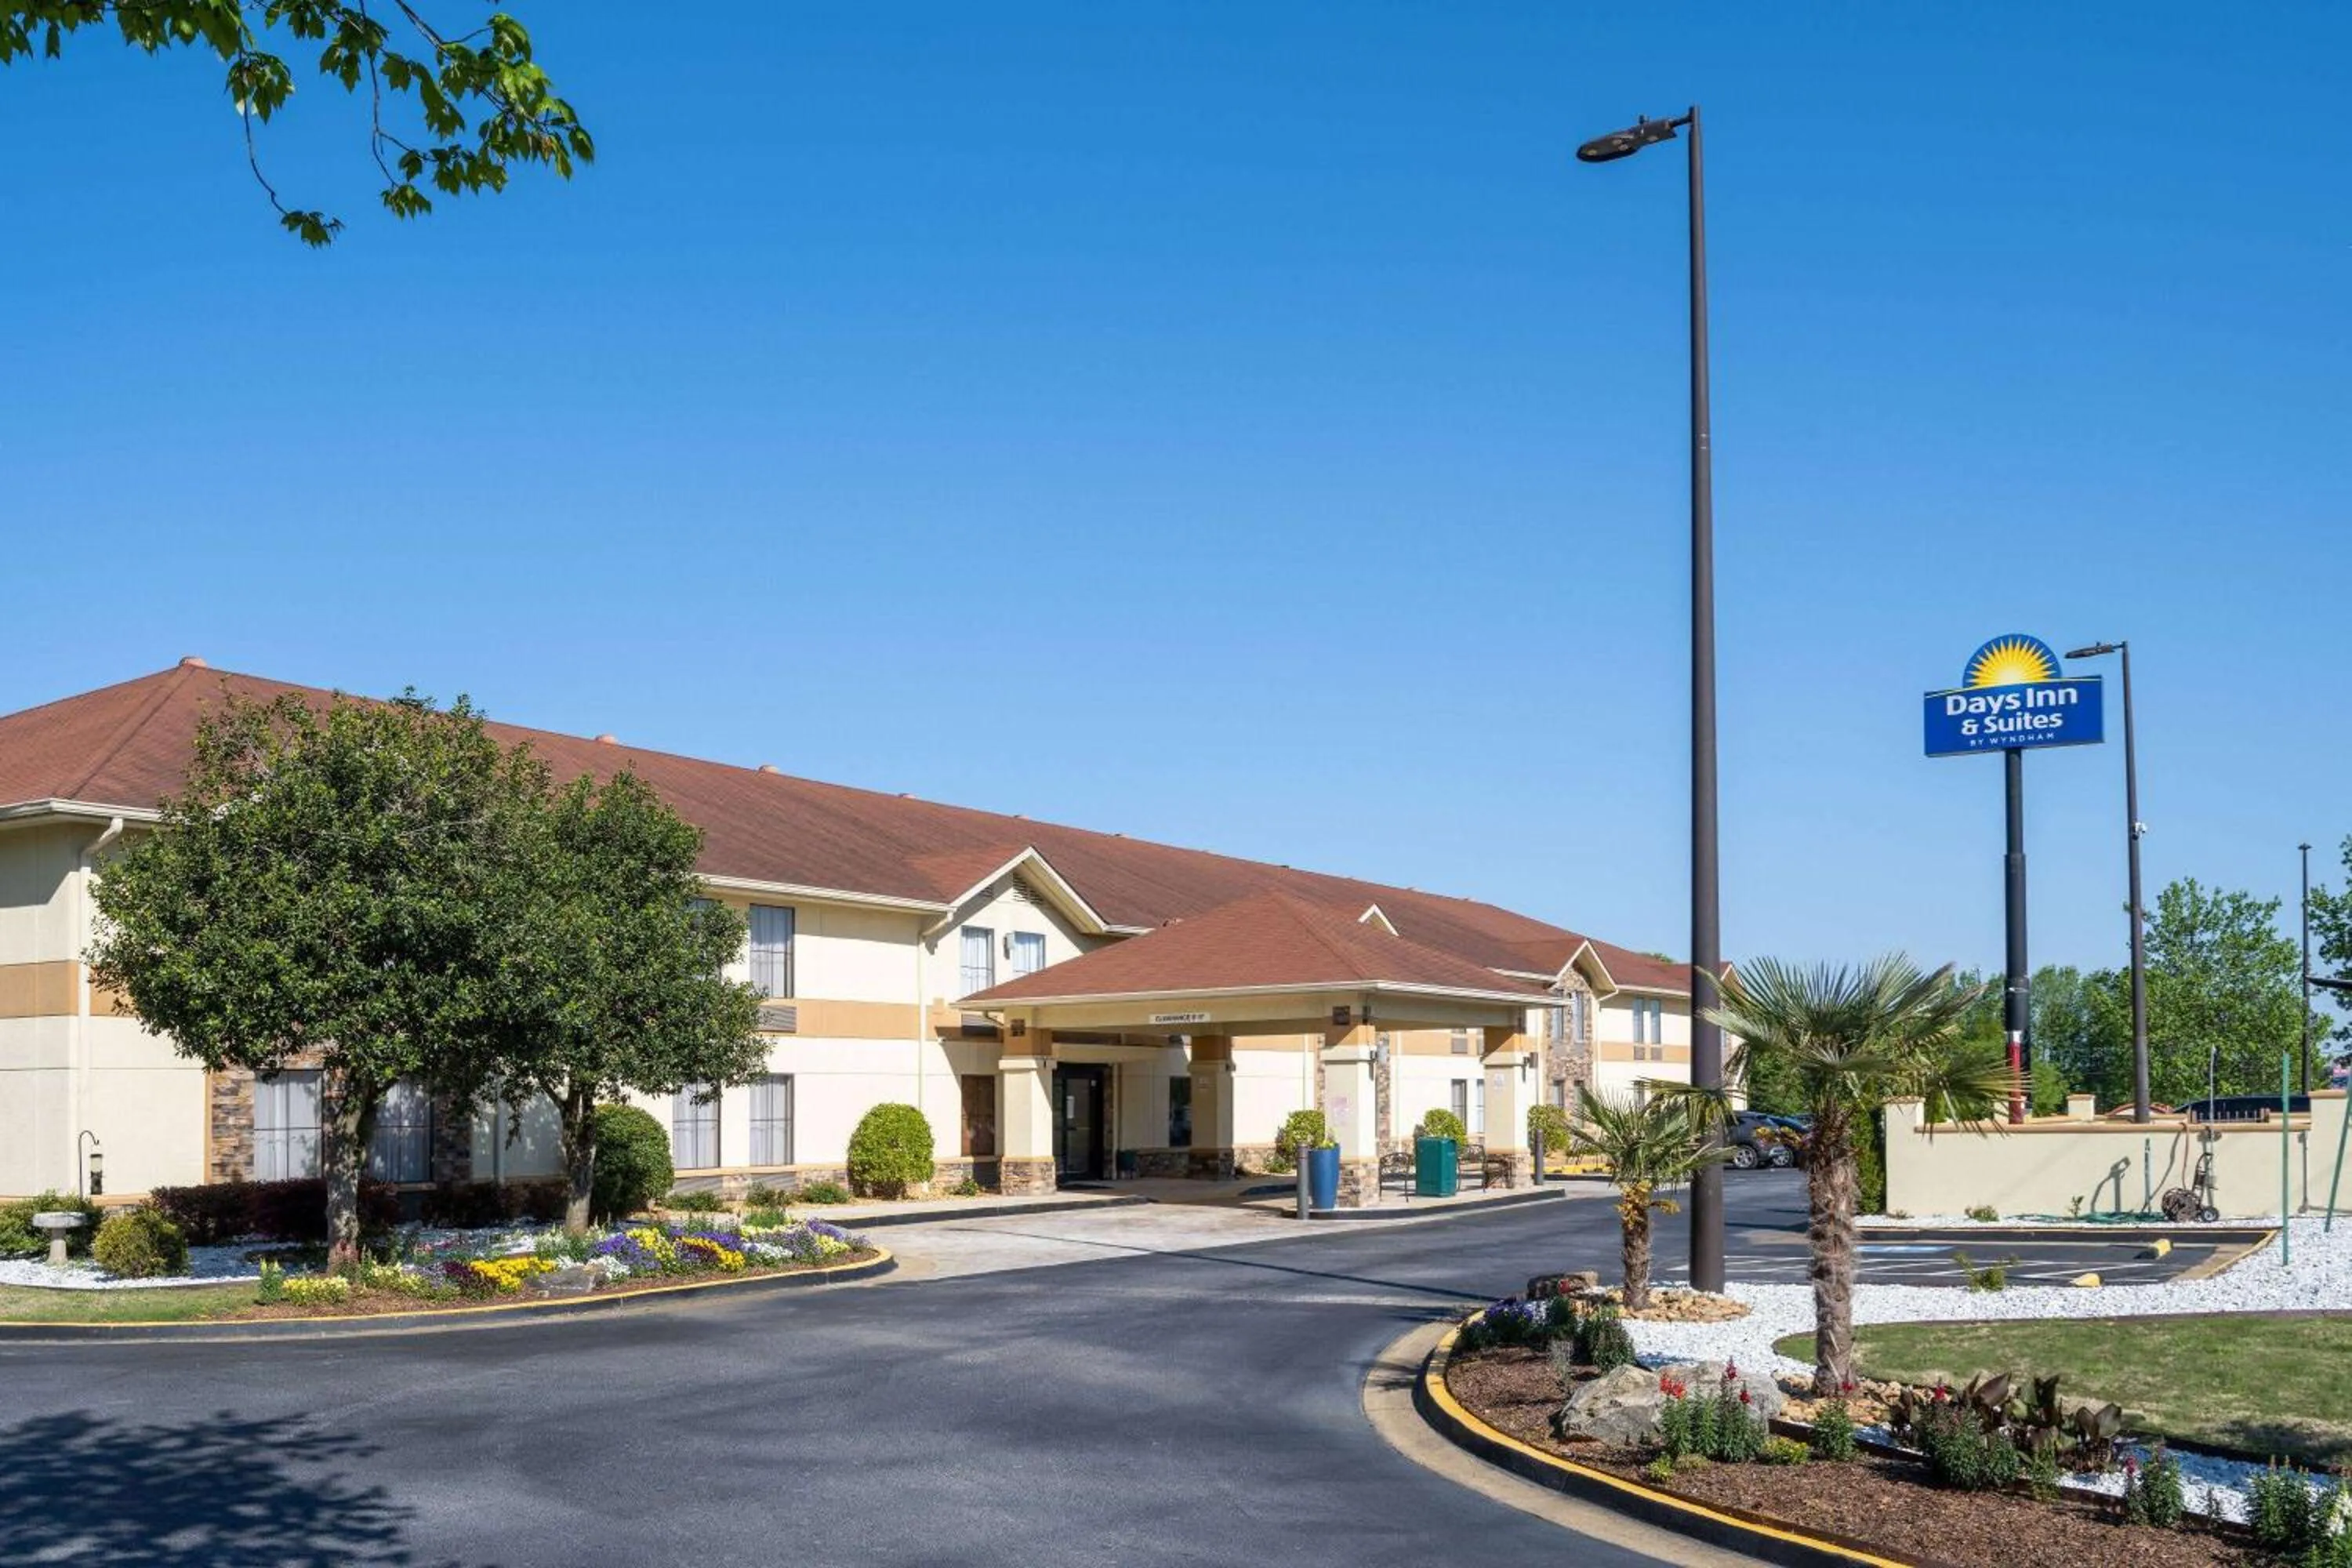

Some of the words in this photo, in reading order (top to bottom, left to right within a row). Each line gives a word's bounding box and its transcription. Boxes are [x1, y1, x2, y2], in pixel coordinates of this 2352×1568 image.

[1946, 692, 2020, 716] Days
[2026, 688, 2078, 708] Inn
[1962, 719, 1979, 735] &
[1984, 712, 2063, 734] Suites
[1990, 732, 2054, 745] WYNDHAM
